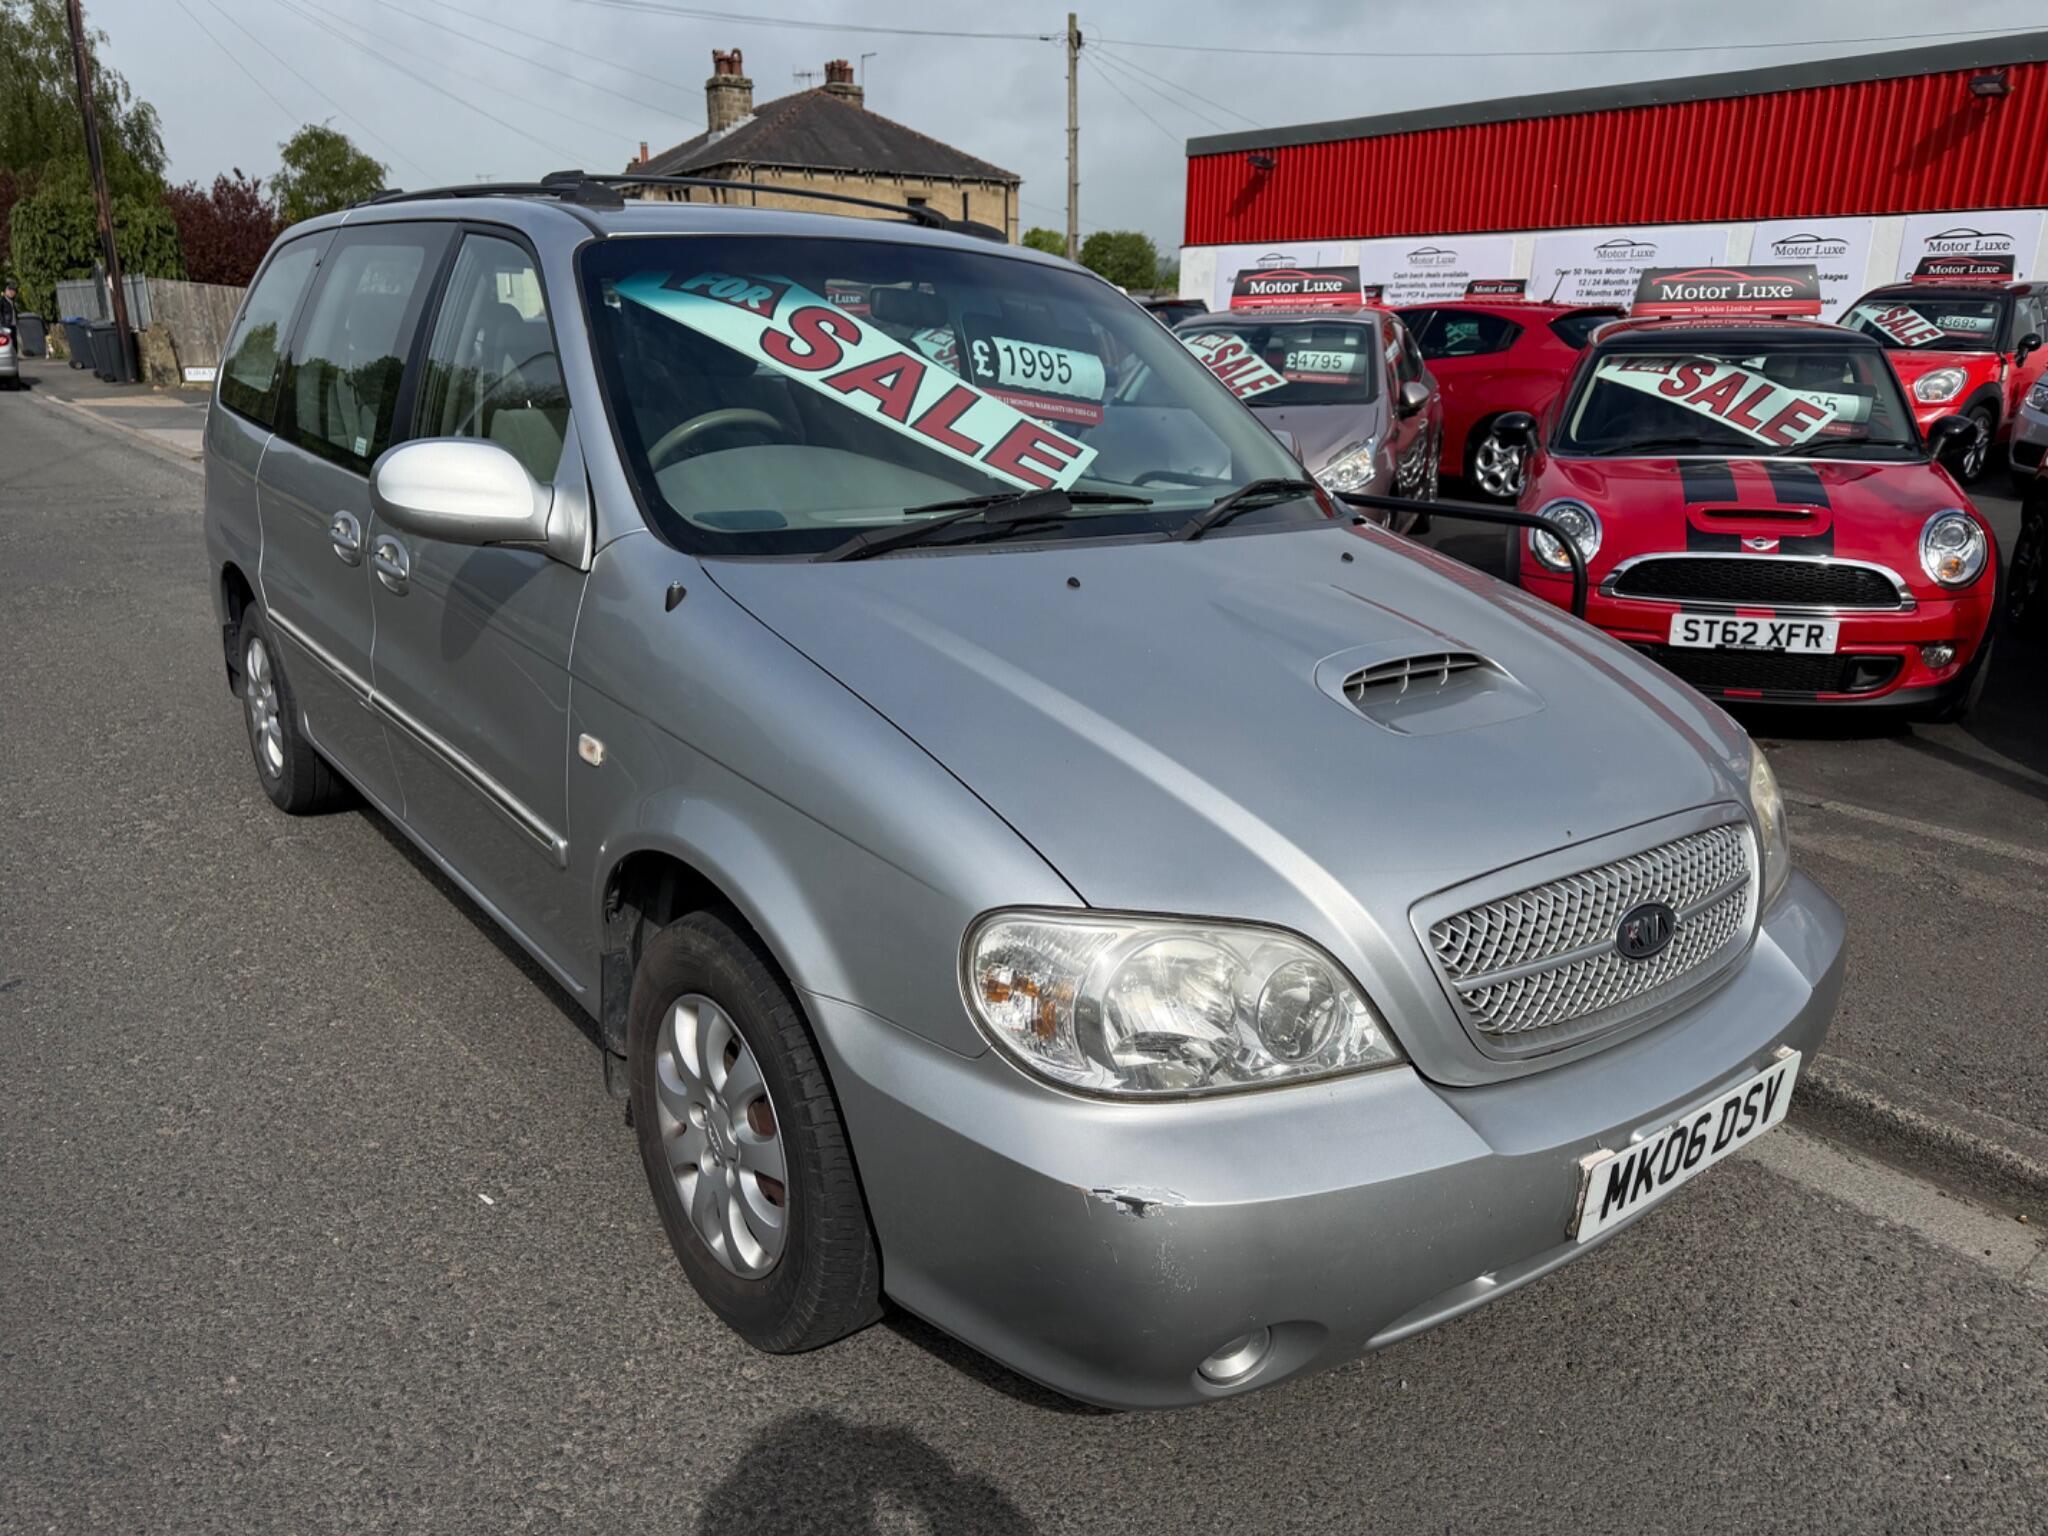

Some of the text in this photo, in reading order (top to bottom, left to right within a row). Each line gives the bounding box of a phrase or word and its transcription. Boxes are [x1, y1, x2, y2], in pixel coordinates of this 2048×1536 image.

[1774, 244, 1846, 256] Motor Luxe
[1928, 240, 2010, 252] Motor Luxe
[1409, 255, 1457, 265] Motor Luxe
[1596, 249, 1656, 259] Motor Luxe
[1442, 270, 1469, 278] available
[1605, 267, 1626, 275] Motor
[1928, 264, 2000, 274] Motor Luxe
[1250, 280, 1299, 295] Motor
[1303, 279, 1342, 293] Luxe
[1602, 278, 1629, 286] Months
[680, 272, 774, 310] FOR
[1473, 285, 1519, 294] Motor Luxe
[1585, 289, 1611, 297] Months
[1613, 288, 1631, 296] MOT
[1661, 282, 1793, 300] Motor Luxe
[835, 293, 862, 305] Luxe
[1874, 305, 1941, 346] SALE
[972, 338, 1073, 385] £1995
[1286, 352, 1343, 370] £4795
[1201, 343, 1280, 398] SALE
[758, 305, 1084, 493] SALE
[1658, 360, 1828, 446] SALE
[1683, 618, 1825, 649] ST62 XFR
[1598, 1068, 1786, 1222] MK06 DSV
